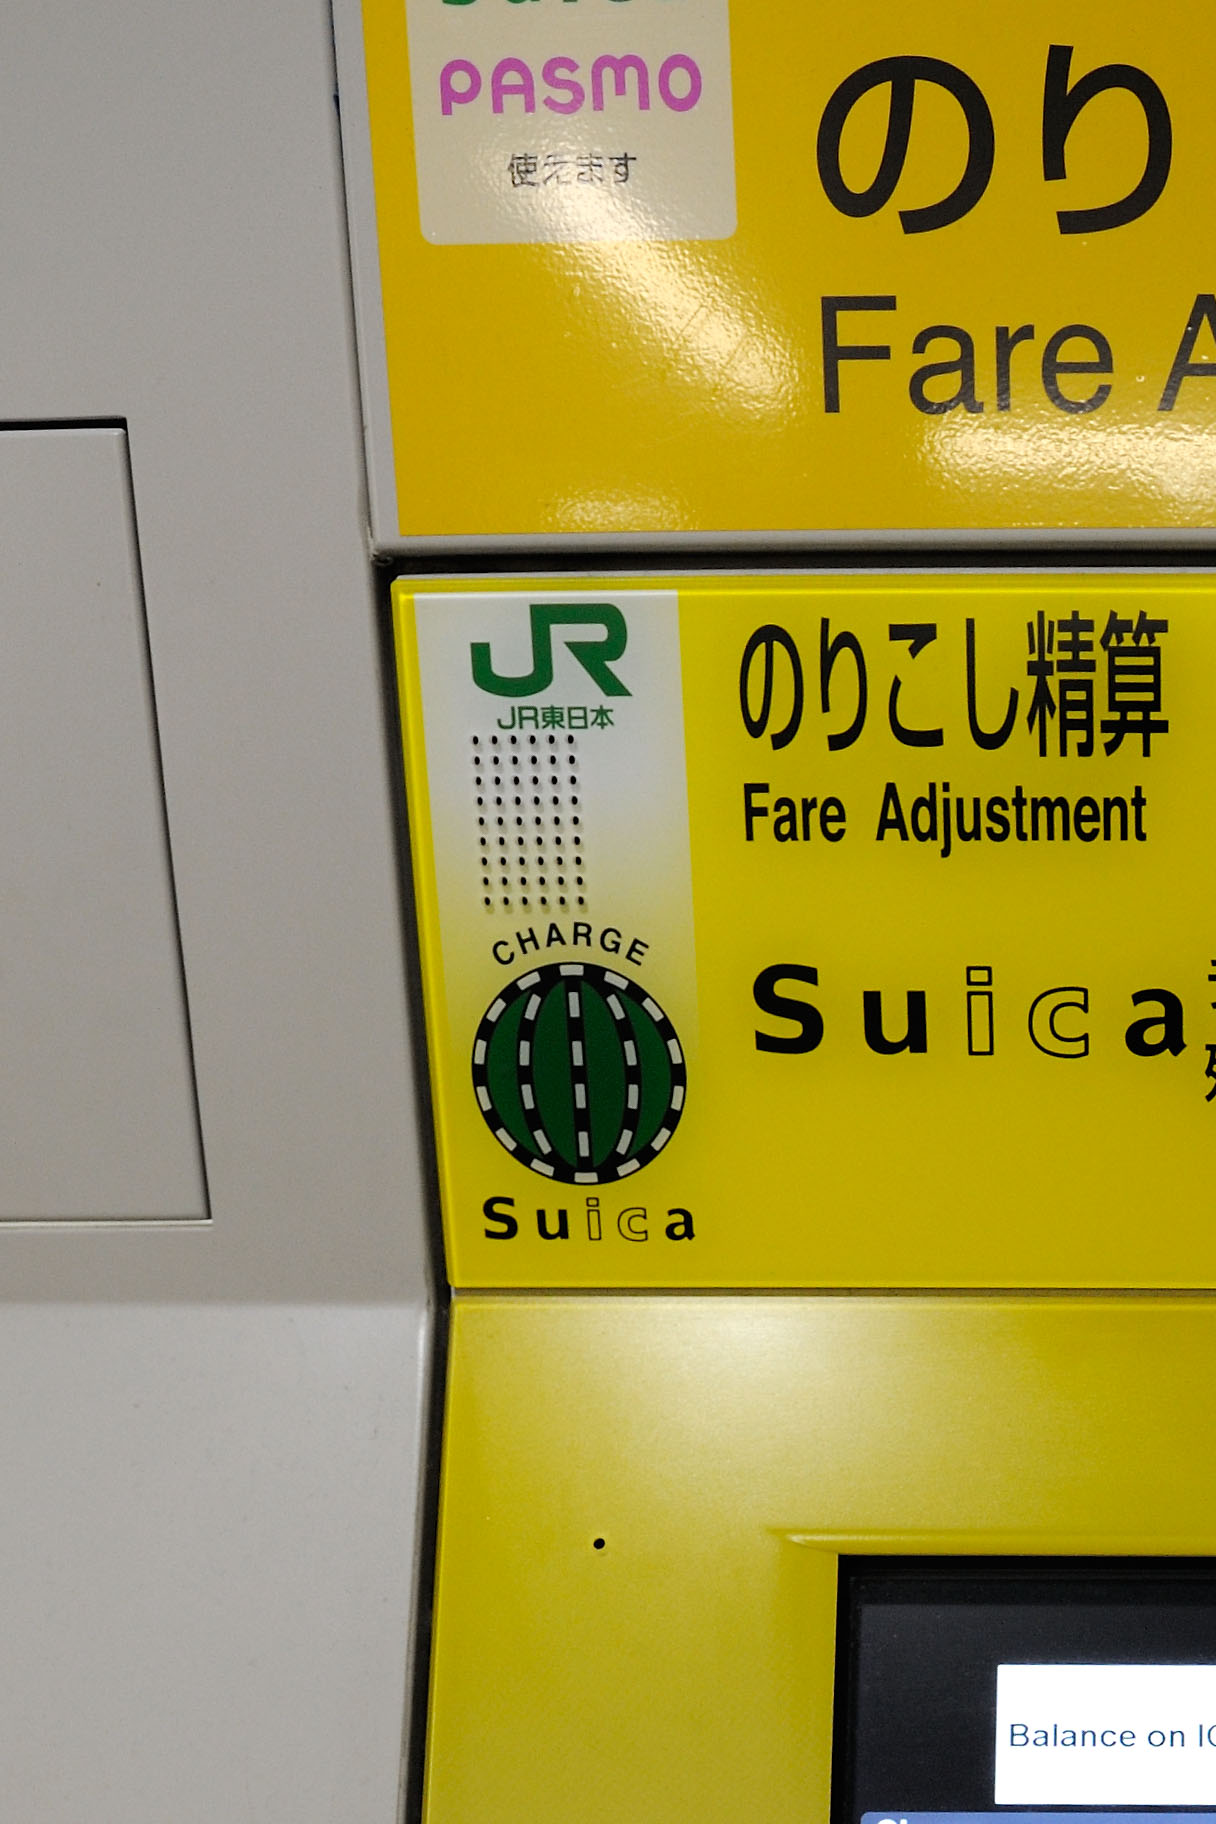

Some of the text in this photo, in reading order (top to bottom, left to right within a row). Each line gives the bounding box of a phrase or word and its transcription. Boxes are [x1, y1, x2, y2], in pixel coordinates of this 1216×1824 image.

[440, 54, 702, 115] PASMO
[507, 152, 637, 187] 使えます
[820, 295, 1114, 414] Fare
[470, 603, 632, 698] JR
[740, 610, 1169, 757] のりこし精算
[497, 705, 614, 729] JR東日本
[744, 782, 1146, 858] Fare Adjustment
[492, 922, 649, 968] CHARGE
[753, 964, 1187, 1059] Suica
[483, 1197, 695, 1242] Suica
[1010, 1724, 1135, 1747] Balance
[1148, 1731, 1184, 1747] on
